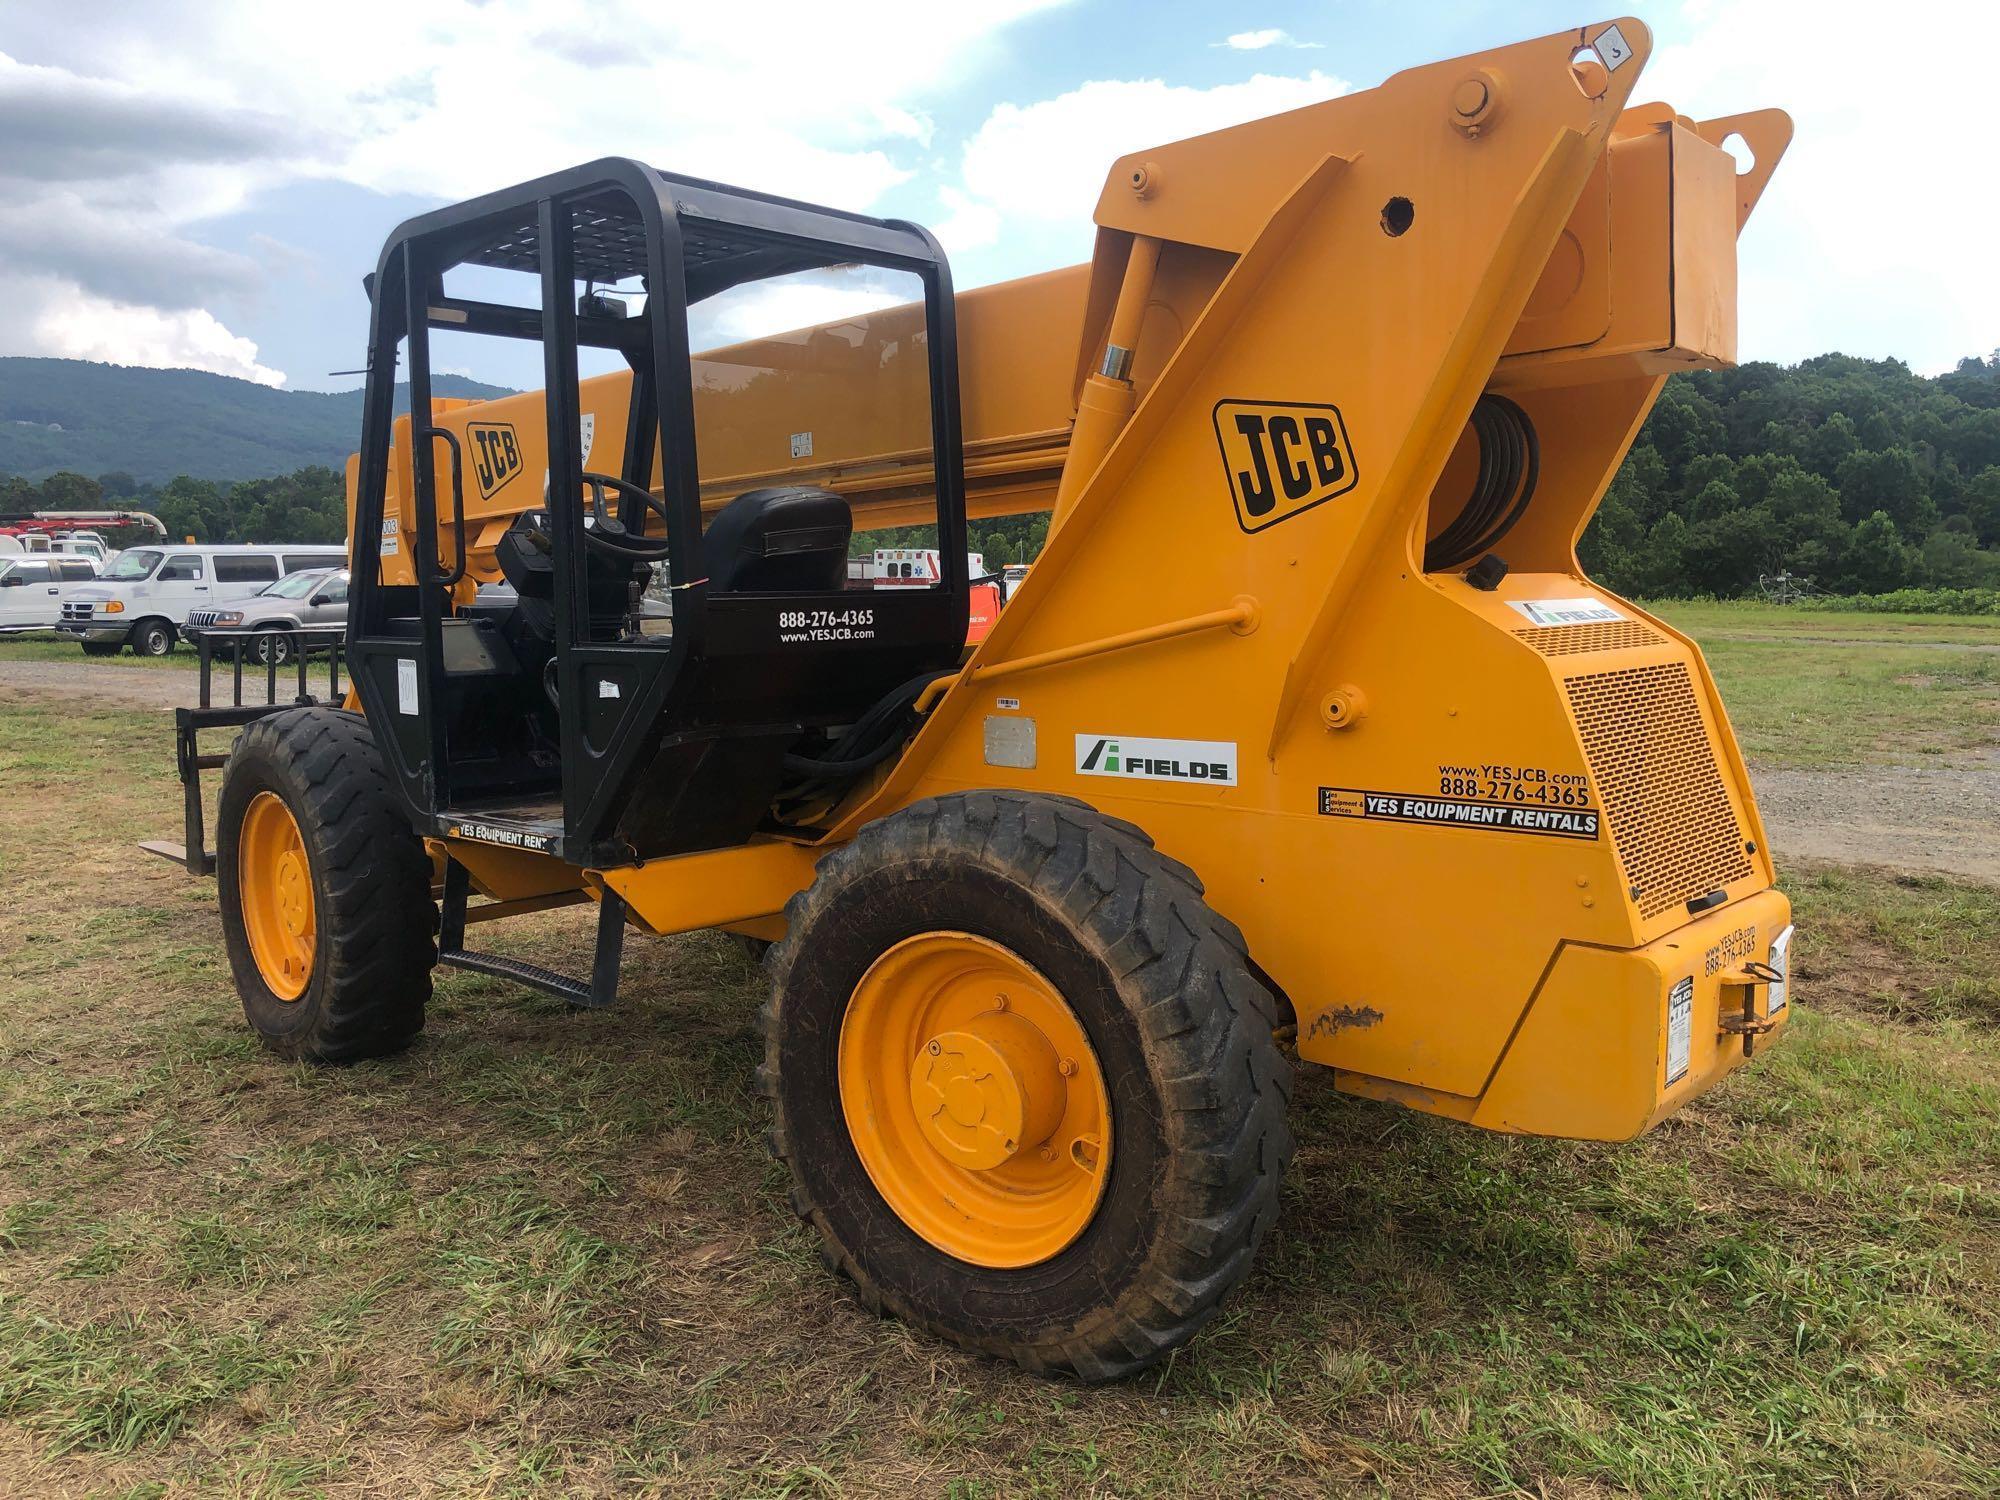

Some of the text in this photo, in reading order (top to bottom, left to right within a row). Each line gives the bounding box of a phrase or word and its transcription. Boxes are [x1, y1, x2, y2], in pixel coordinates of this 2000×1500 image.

[474, 430, 519, 491] JCB
[1234, 414, 1345, 517] JCB
[779, 609, 874, 628] 888-276-4365
[1555, 609, 1619, 622] FIELDS
[780, 628, 875, 643] www.YESJCB.com
[1125, 757, 1229, 781] FIELDS
[1438, 765, 1588, 786] www.YESJCB.com
[1440, 777, 1590, 807] 888-276-4365
[1366, 797, 1598, 833] YES EQUIPMENT RENTALS
[460, 823, 475, 837] YES
[475, 826, 523, 845] EQUIPMENT
[1705, 925, 1756, 958] www.YESJCB.com
[1705, 934, 1756, 978] 888-276-4365
